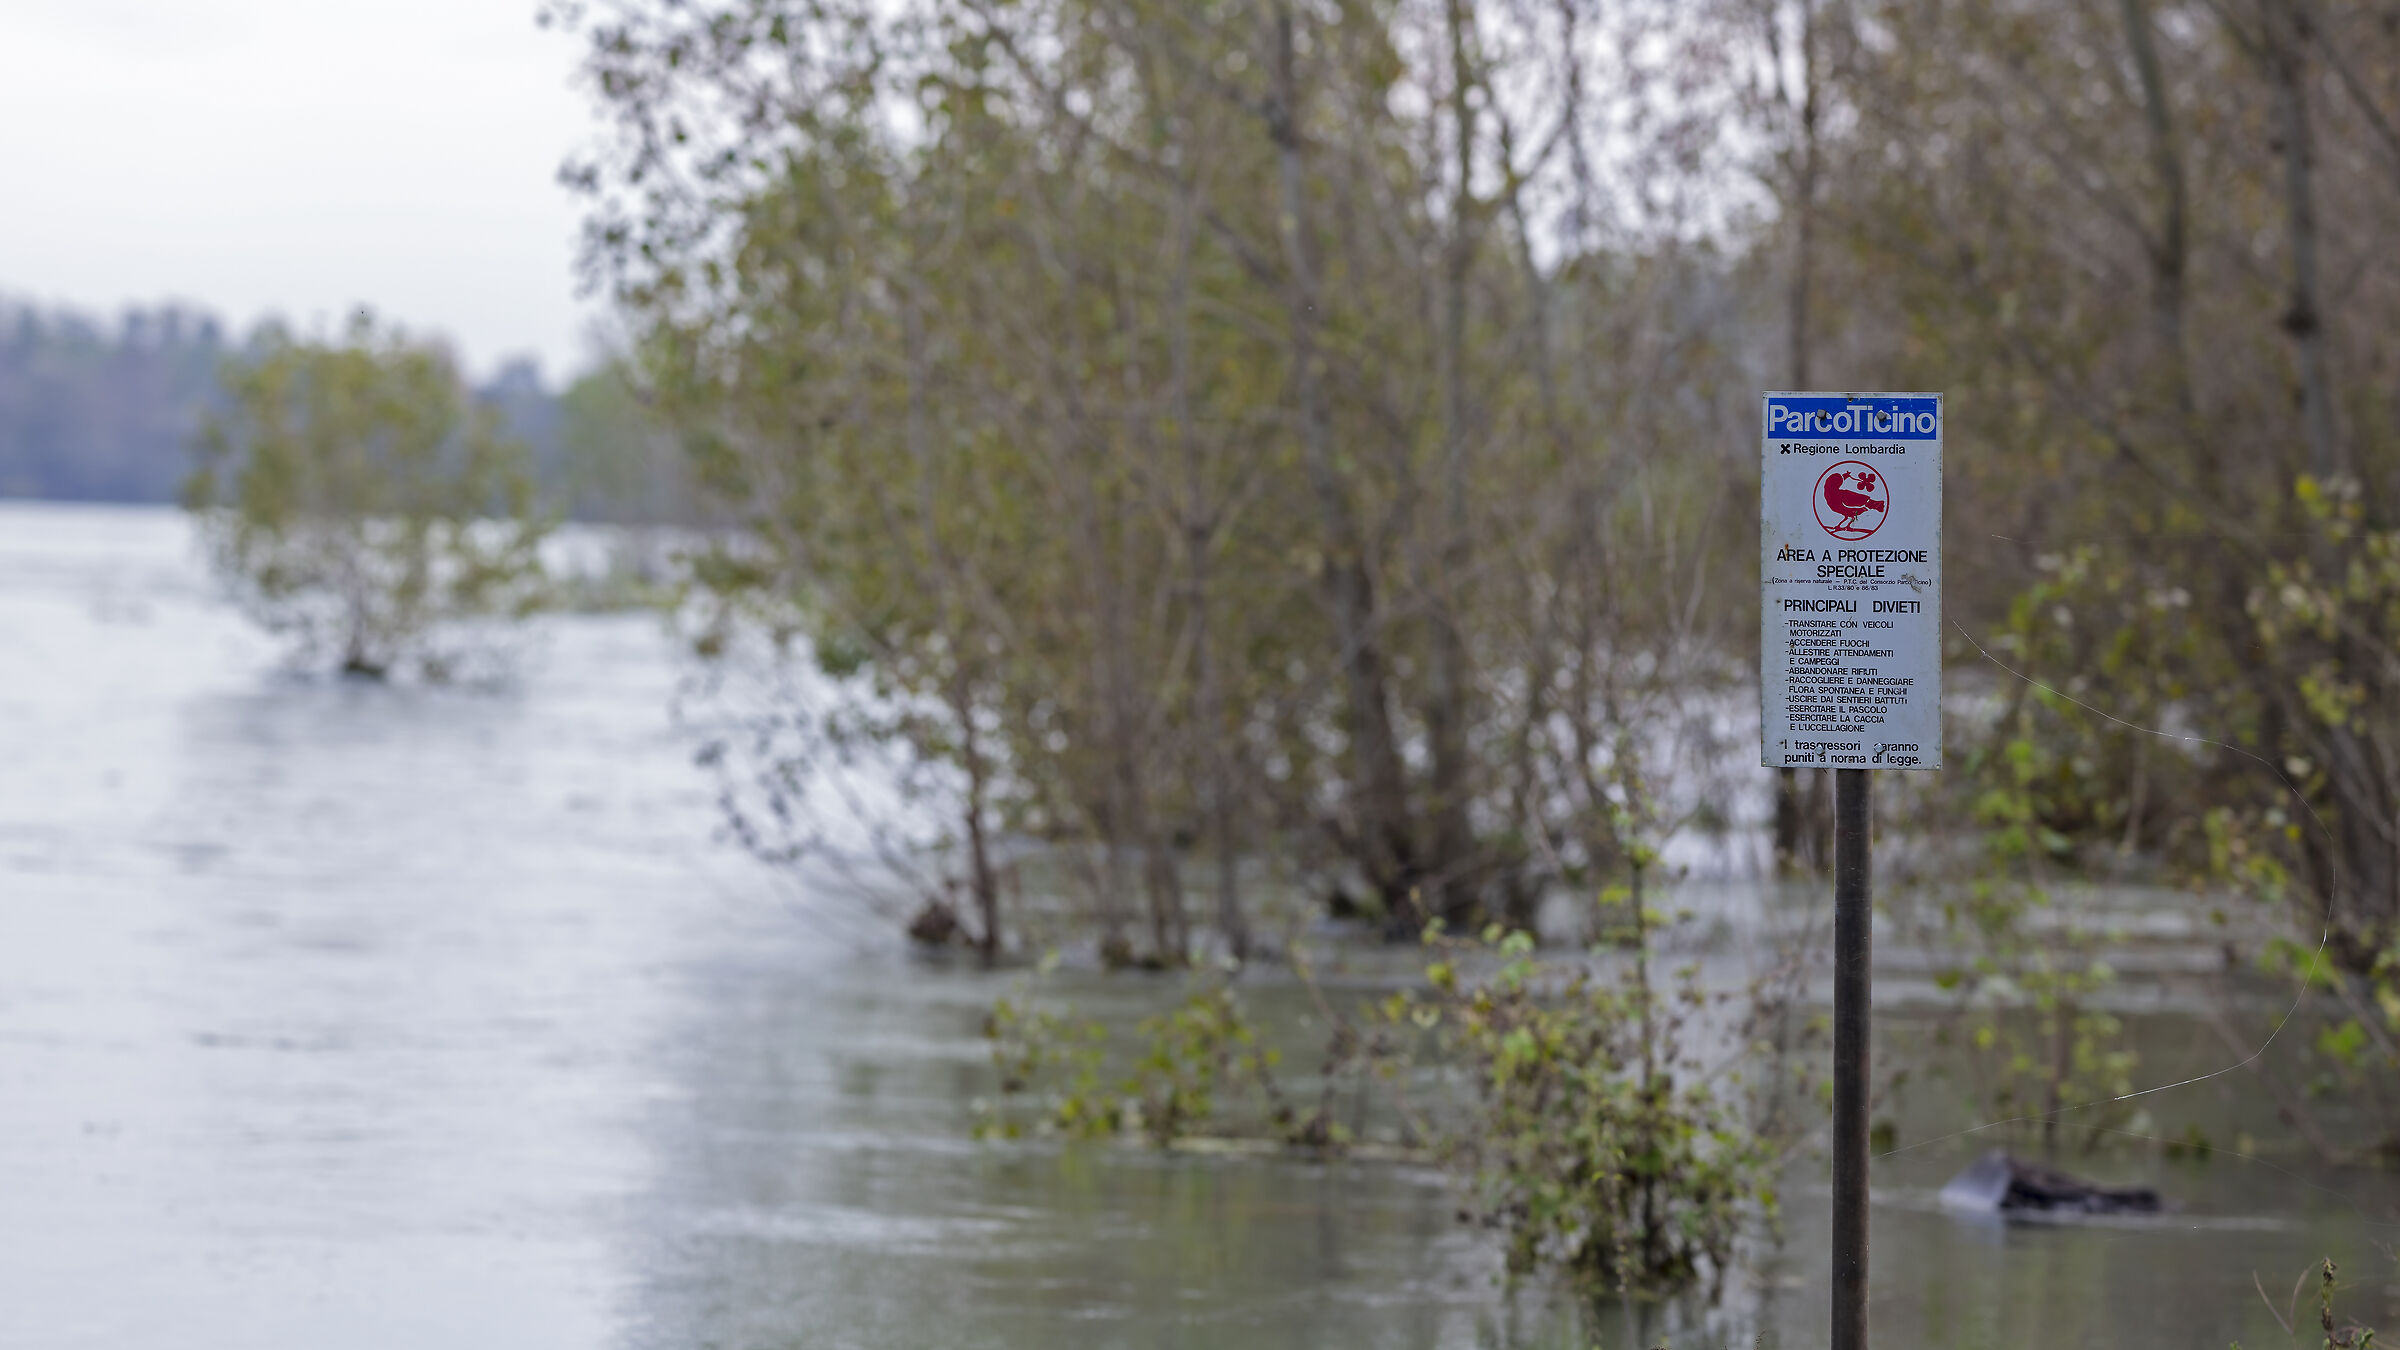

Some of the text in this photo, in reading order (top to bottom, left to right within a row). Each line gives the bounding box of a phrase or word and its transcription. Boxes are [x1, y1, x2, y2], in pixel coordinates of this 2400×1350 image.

[1793, 443, 1906, 455] Regione Lombardia
[1777, 549, 1928, 563] AREA A PROTEZIONE
[1817, 565, 1885, 578] SPECIALE
[1784, 600, 1921, 614] PRINCIPALI DIVIETI
[1839, 620, 1858, 629] CON
[1862, 621, 1894, 629] VEICOLI
[1789, 629, 1842, 637] MOTORIZZATI
[1839, 640, 1870, 648] FUOCHI
[1833, 649, 1894, 658] ATTENDAMENTI
[1797, 658, 1840, 666] CAMPEGGI
[1851, 668, 1878, 676] RIFIUTI
[1848, 677, 1853, 685] E
[1856, 677, 1914, 686] DANNEGGIARE
[1788, 686, 1908, 696] FLORA SPONTANEA E FUNGHI
[1836, 696, 1872, 704] SENTIERI
[1874, 697, 1908, 705] BATTUTI
[1848, 706, 1888, 714] PASCOLO
[1853, 715, 1885, 723] CACCIA
[1798, 724, 1865, 732] L'UCCELLAGIONE
[1873, 742, 1919, 752] aranno
[1784, 752, 1815, 764] puniti
[1831, 754, 1866, 763] norma
[1872, 752, 1882, 763] di
[1886, 754, 1922, 766] legge.
